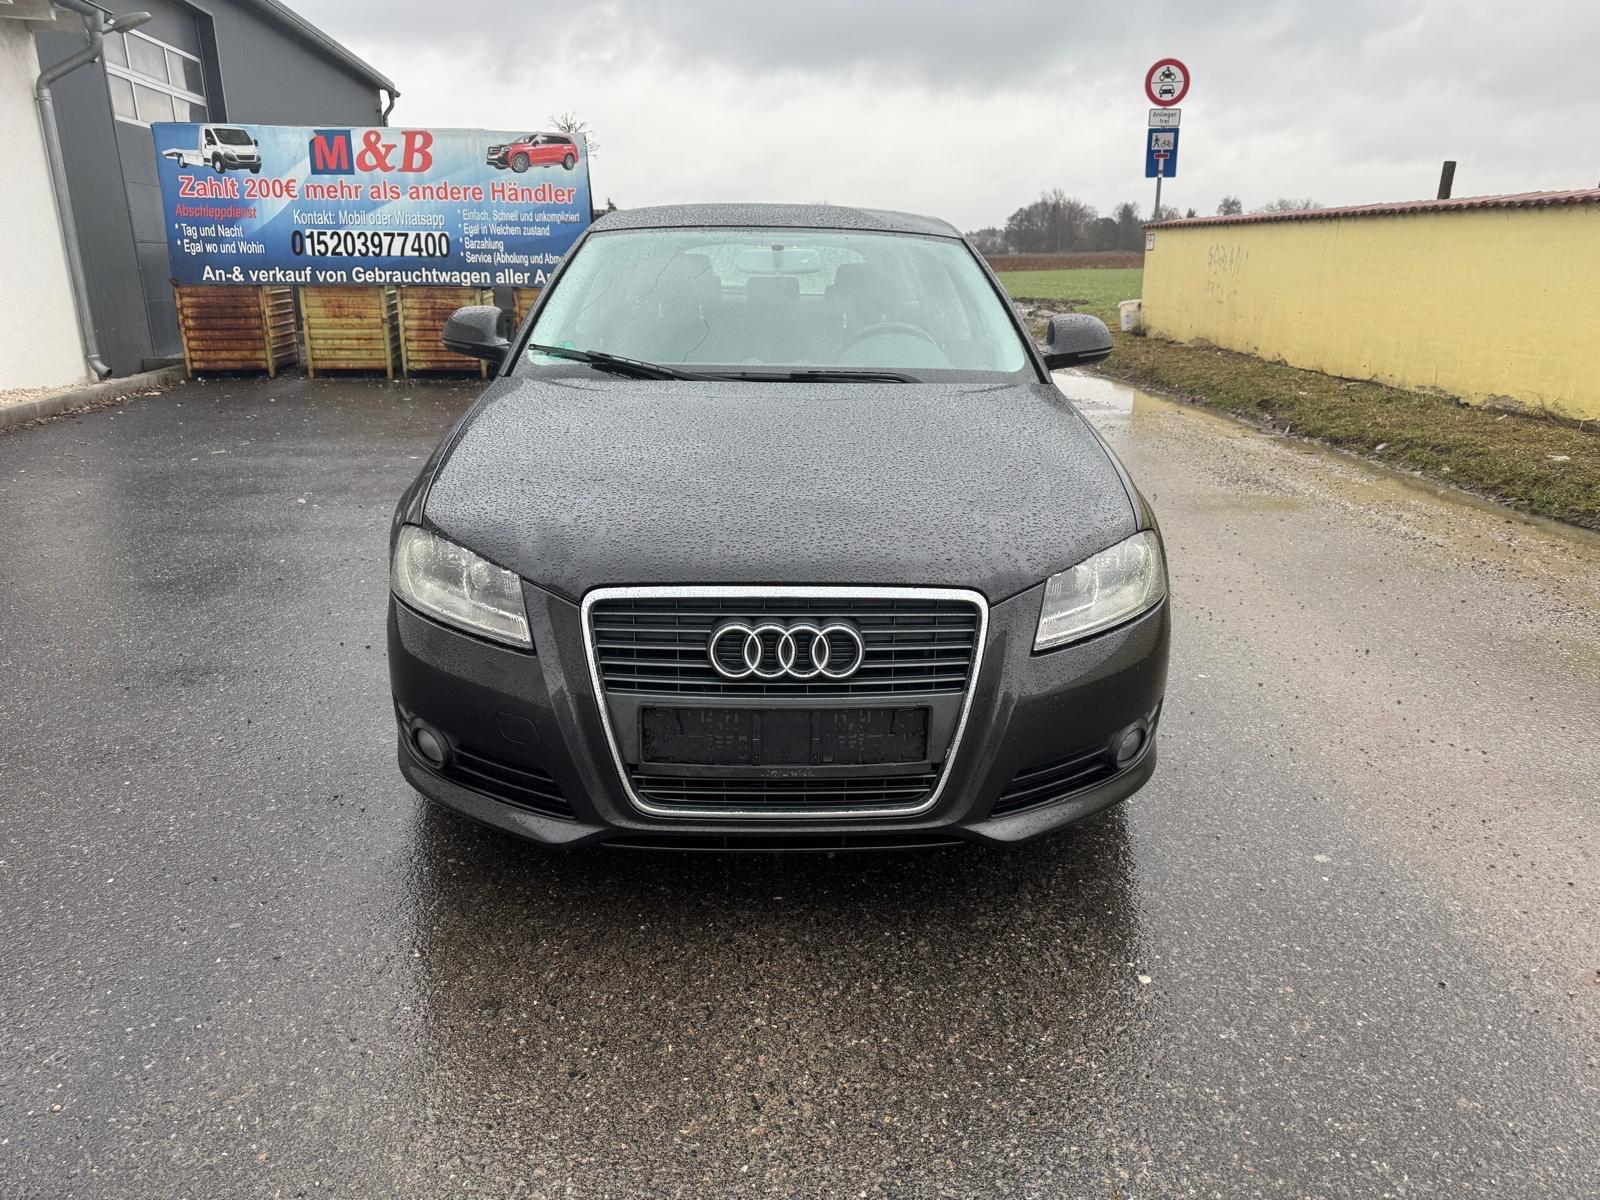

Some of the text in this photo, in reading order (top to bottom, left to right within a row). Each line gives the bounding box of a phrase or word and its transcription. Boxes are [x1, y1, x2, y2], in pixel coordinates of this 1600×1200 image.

[314, 129, 433, 172] M&B
[179, 177, 575, 203] Zahlt 200€ mehr als andere Händler
[176, 204, 257, 220] Abschleppdienst
[293, 210, 445, 229] Kontakt: Mobil oder Whatsapp
[492, 209, 519, 221] Schnell
[520, 210, 533, 222] und
[534, 211, 580, 224] unkompliziert
[181, 223, 243, 239] Tag und Nacht
[464, 223, 550, 237] Egal in Welchem zustand
[184, 239, 265, 255] Egal wo und Wohin
[291, 229, 450, 257] 015203977400
[464, 237, 504, 252] Barzahlung
[465, 251, 492, 264] Service
[493, 251, 529, 267] (Abholung
[530, 252, 543, 264] und
[202, 265, 244, 282] An-&
[249, 266, 312, 282] verkauf
[316, 270, 347, 283] von
[351, 266, 490, 286] Gebrauchtwagen
[496, 268, 530, 284] aller
